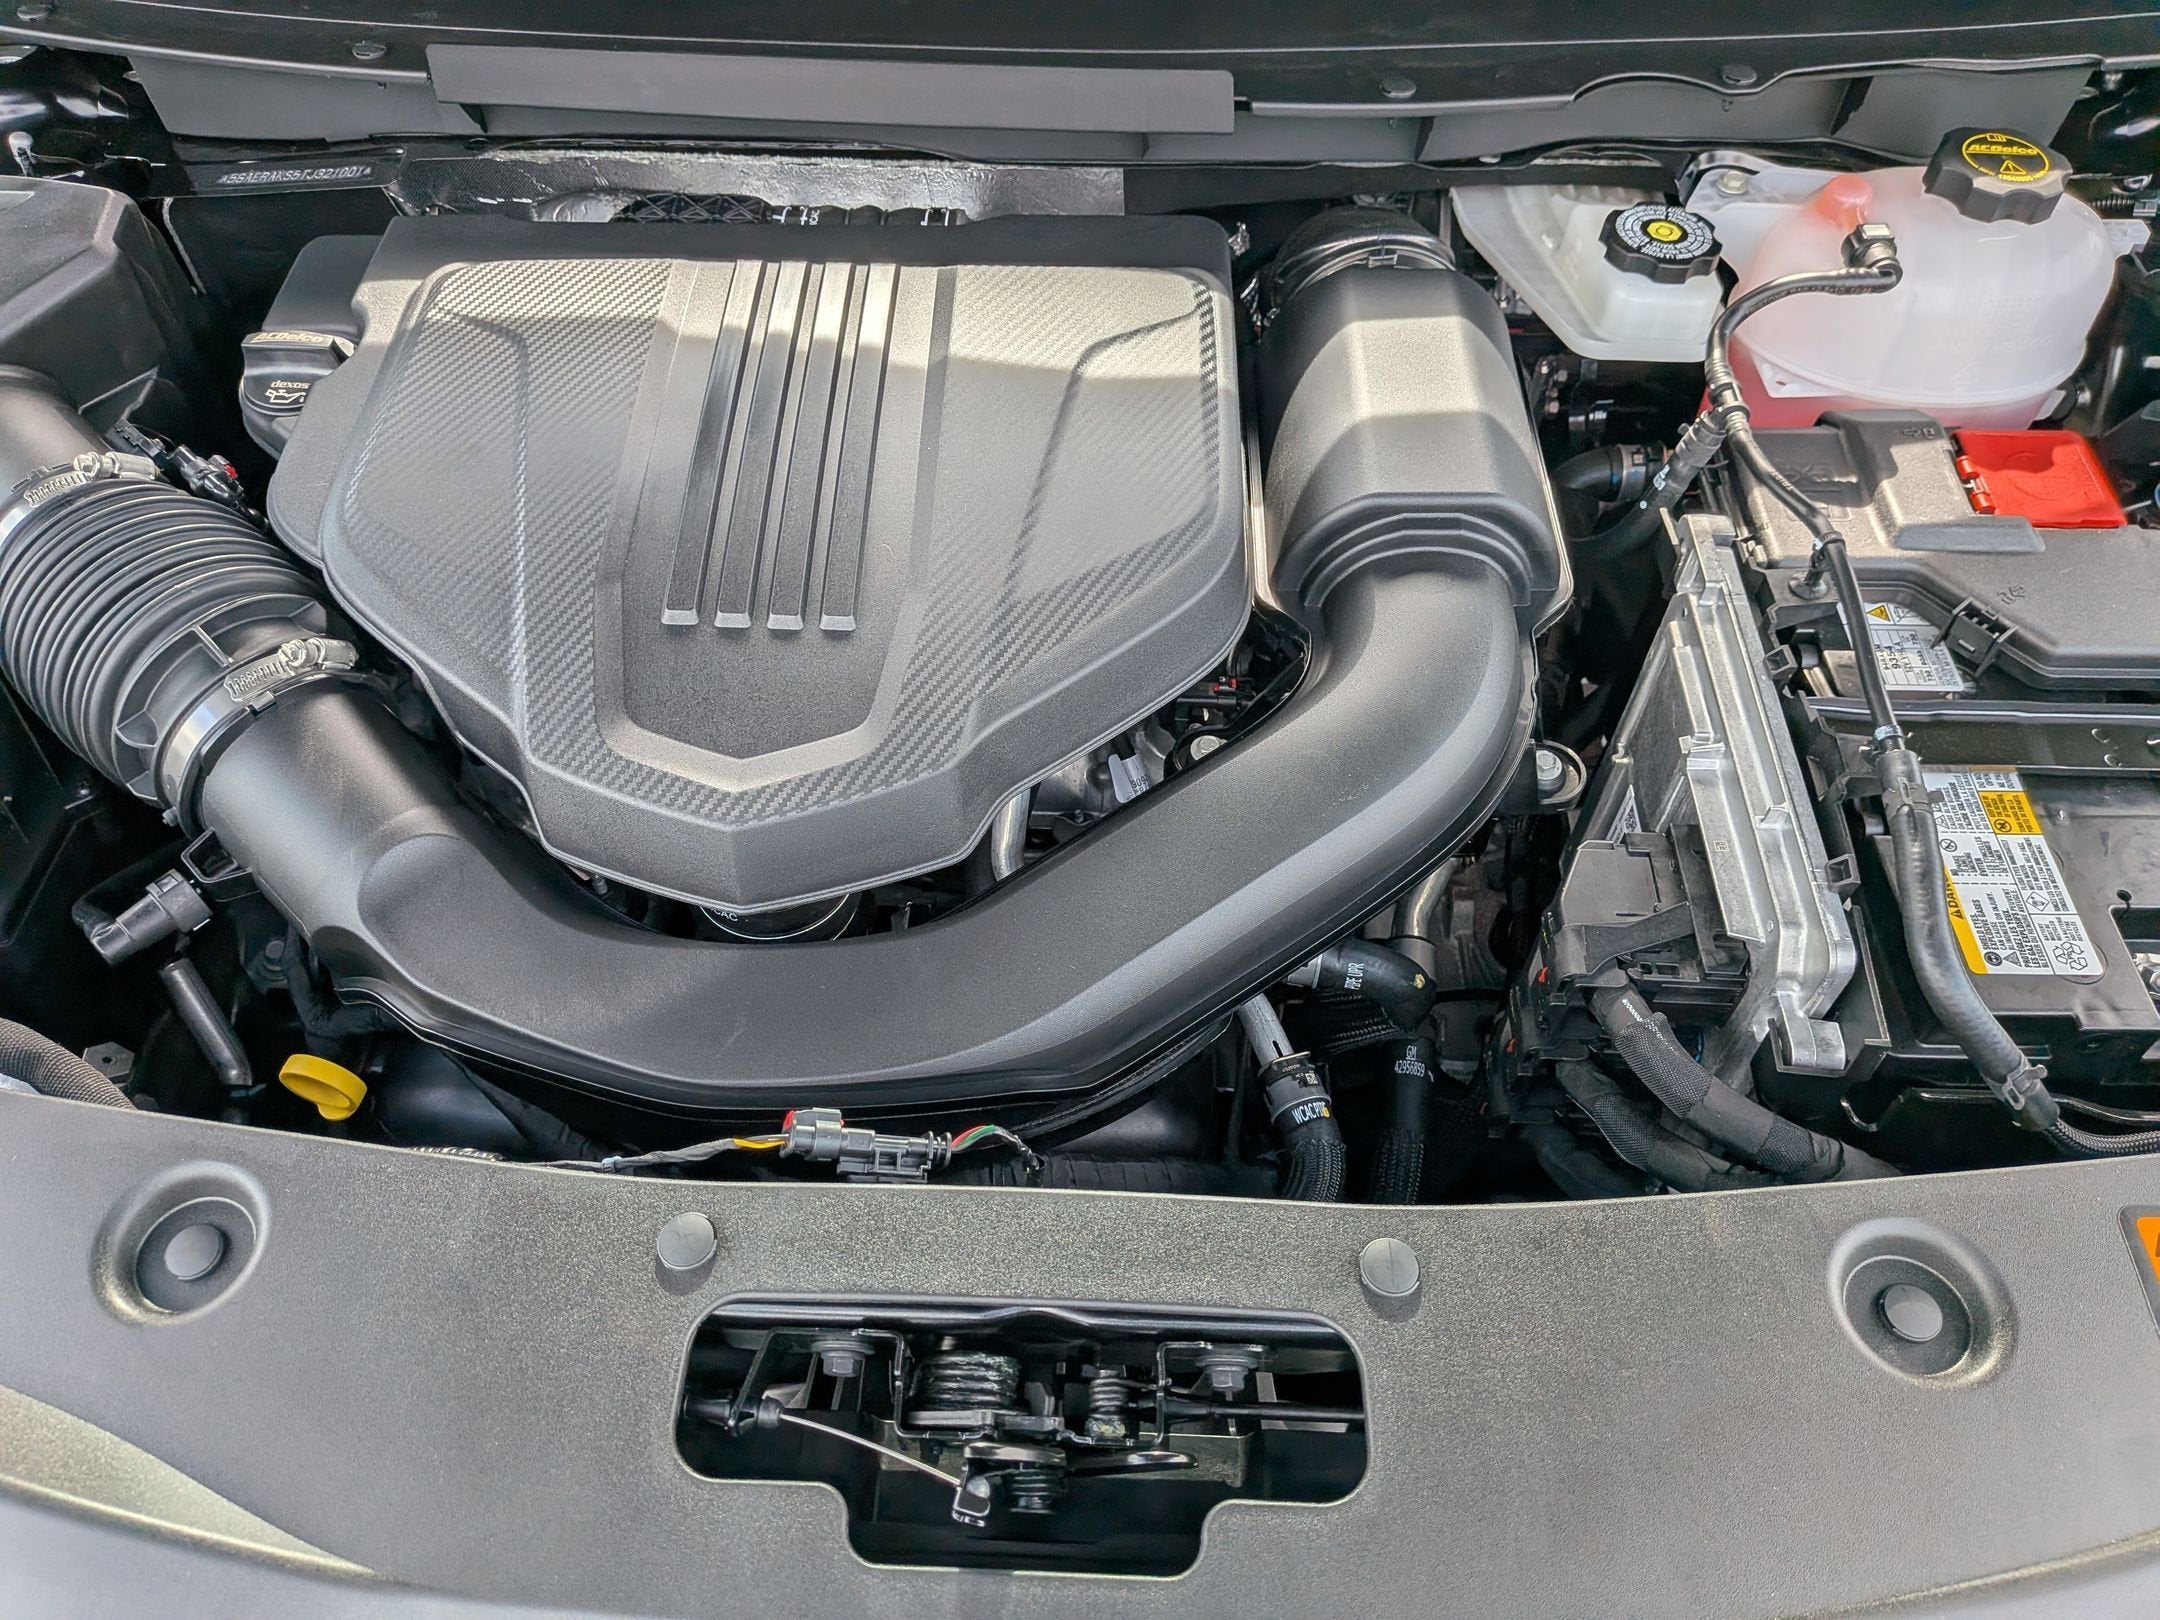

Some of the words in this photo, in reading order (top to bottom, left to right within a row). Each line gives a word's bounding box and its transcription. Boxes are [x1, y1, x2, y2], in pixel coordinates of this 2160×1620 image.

[1966, 143, 2039, 155] ACDelco
[252, 331, 324, 343] ACDelco
[270, 379, 312, 390] dexos
[1884, 645, 1901, 669] 9354
[1971, 898, 1986, 917] GASES
[2000, 887, 2018, 911] PEUVENT
[1979, 918, 1999, 950] EXPLOSIVE
[1989, 921, 2003, 938] CAUSE
[1996, 920, 2016, 950] BLINDNESS
[2007, 924, 2020, 936] LES
[2010, 912, 2031, 943] EXPLOSIFS
[1975, 929, 1991, 950] SHIELD
[1996, 939, 2008, 950] CAN
[2024, 943, 2036, 956] GAZ
[2032, 943, 2049, 968] BLESSER
[1347, 962, 1365, 977] UPR
[2029, 957, 2041, 968] LES
